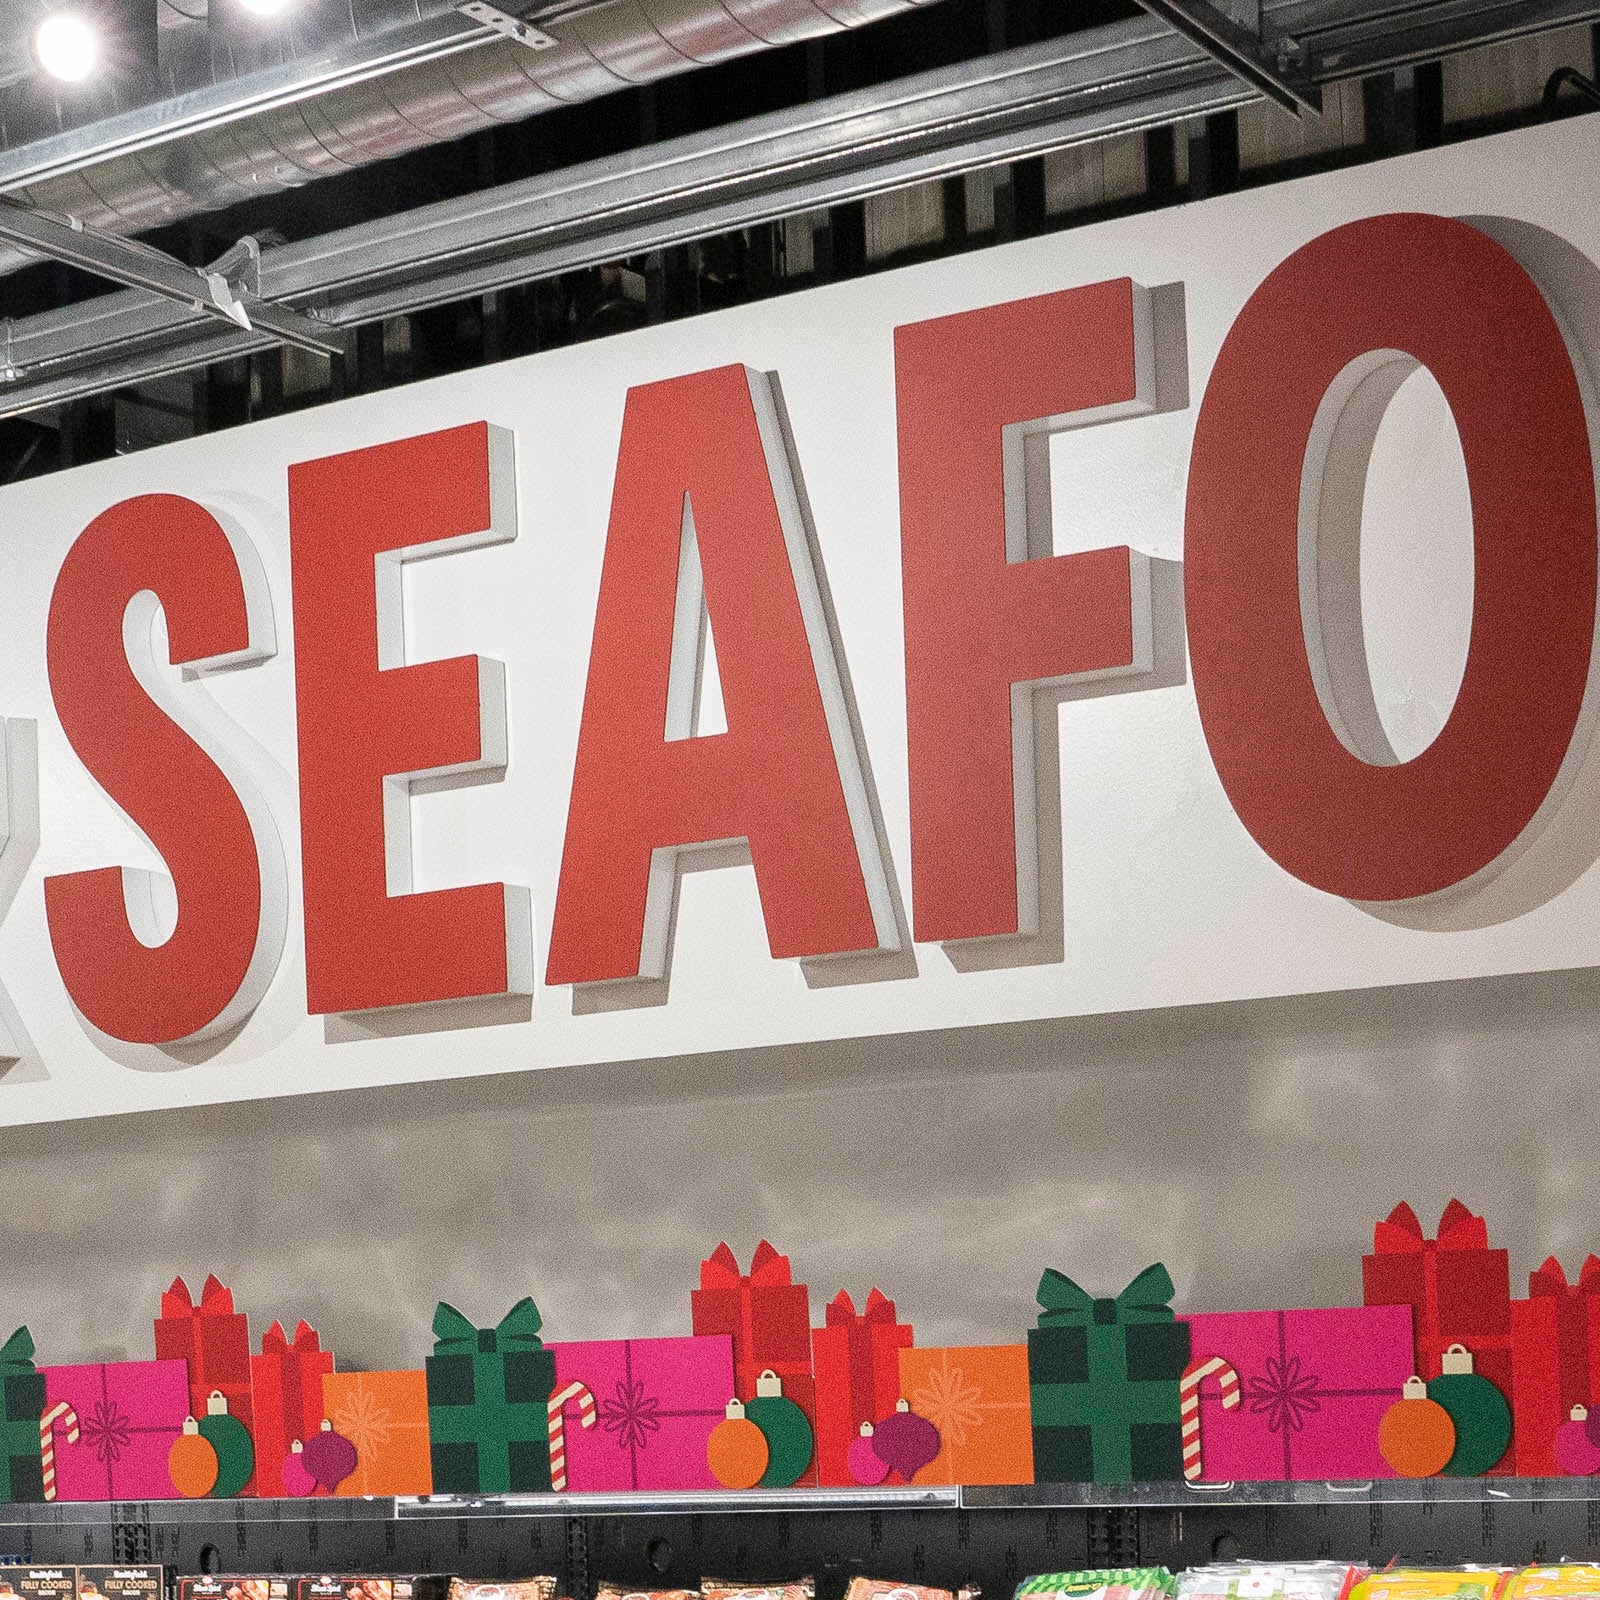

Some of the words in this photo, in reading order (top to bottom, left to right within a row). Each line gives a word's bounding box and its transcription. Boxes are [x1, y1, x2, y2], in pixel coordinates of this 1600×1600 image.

[21, 1580, 39, 1590] FULLY
[40, 1581, 72, 1590] COOKED
[104, 1580, 124, 1590] FULLY
[125, 1580, 157, 1589] COOKED
